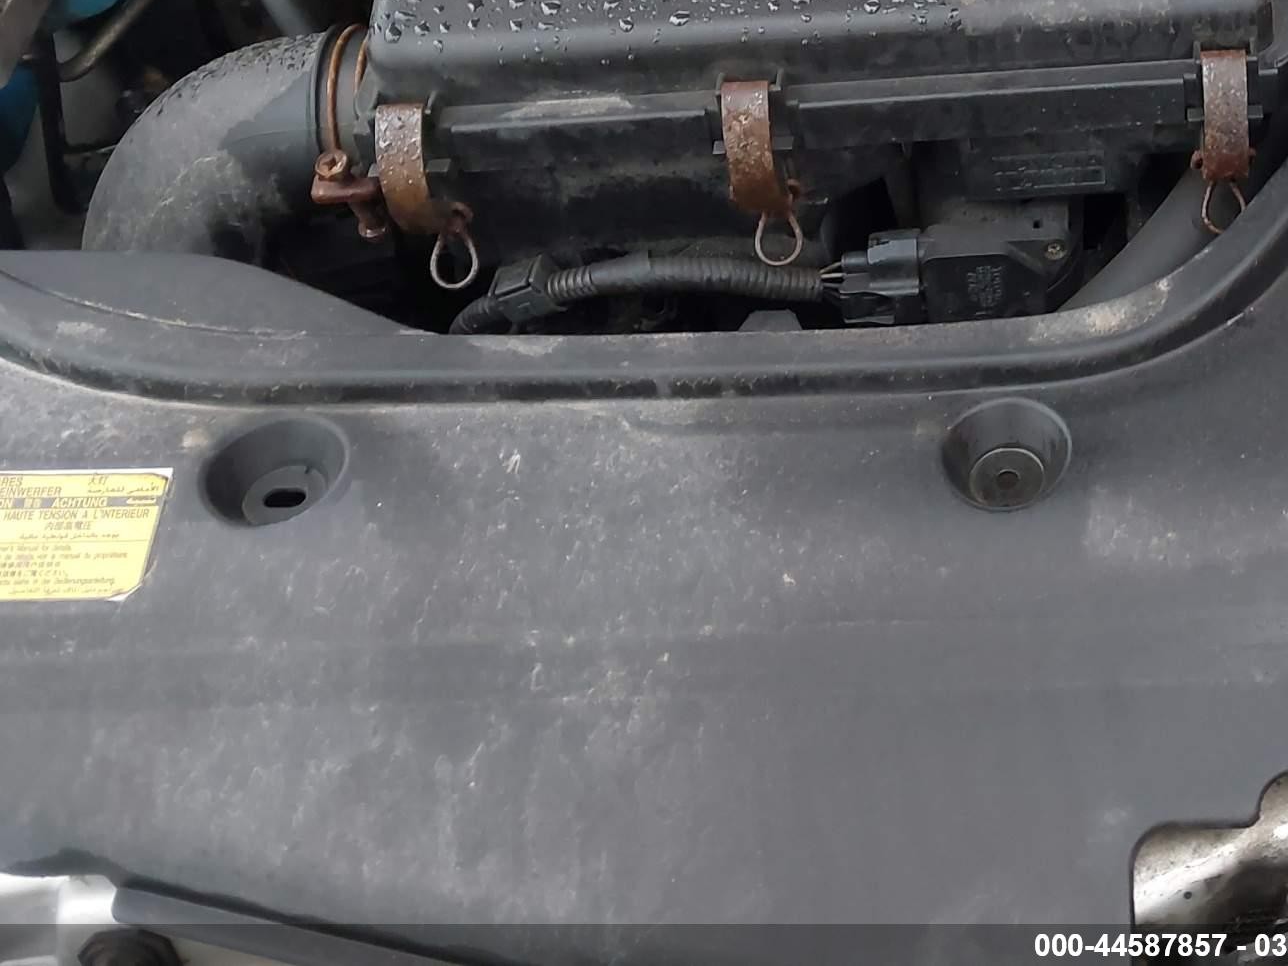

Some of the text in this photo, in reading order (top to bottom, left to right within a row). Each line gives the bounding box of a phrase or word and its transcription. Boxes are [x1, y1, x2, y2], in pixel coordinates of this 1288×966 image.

[51, 496, 108, 508] ACHTUNG
[3, 509, 34, 521] HAUTE
[39, 509, 78, 520] TENSION
